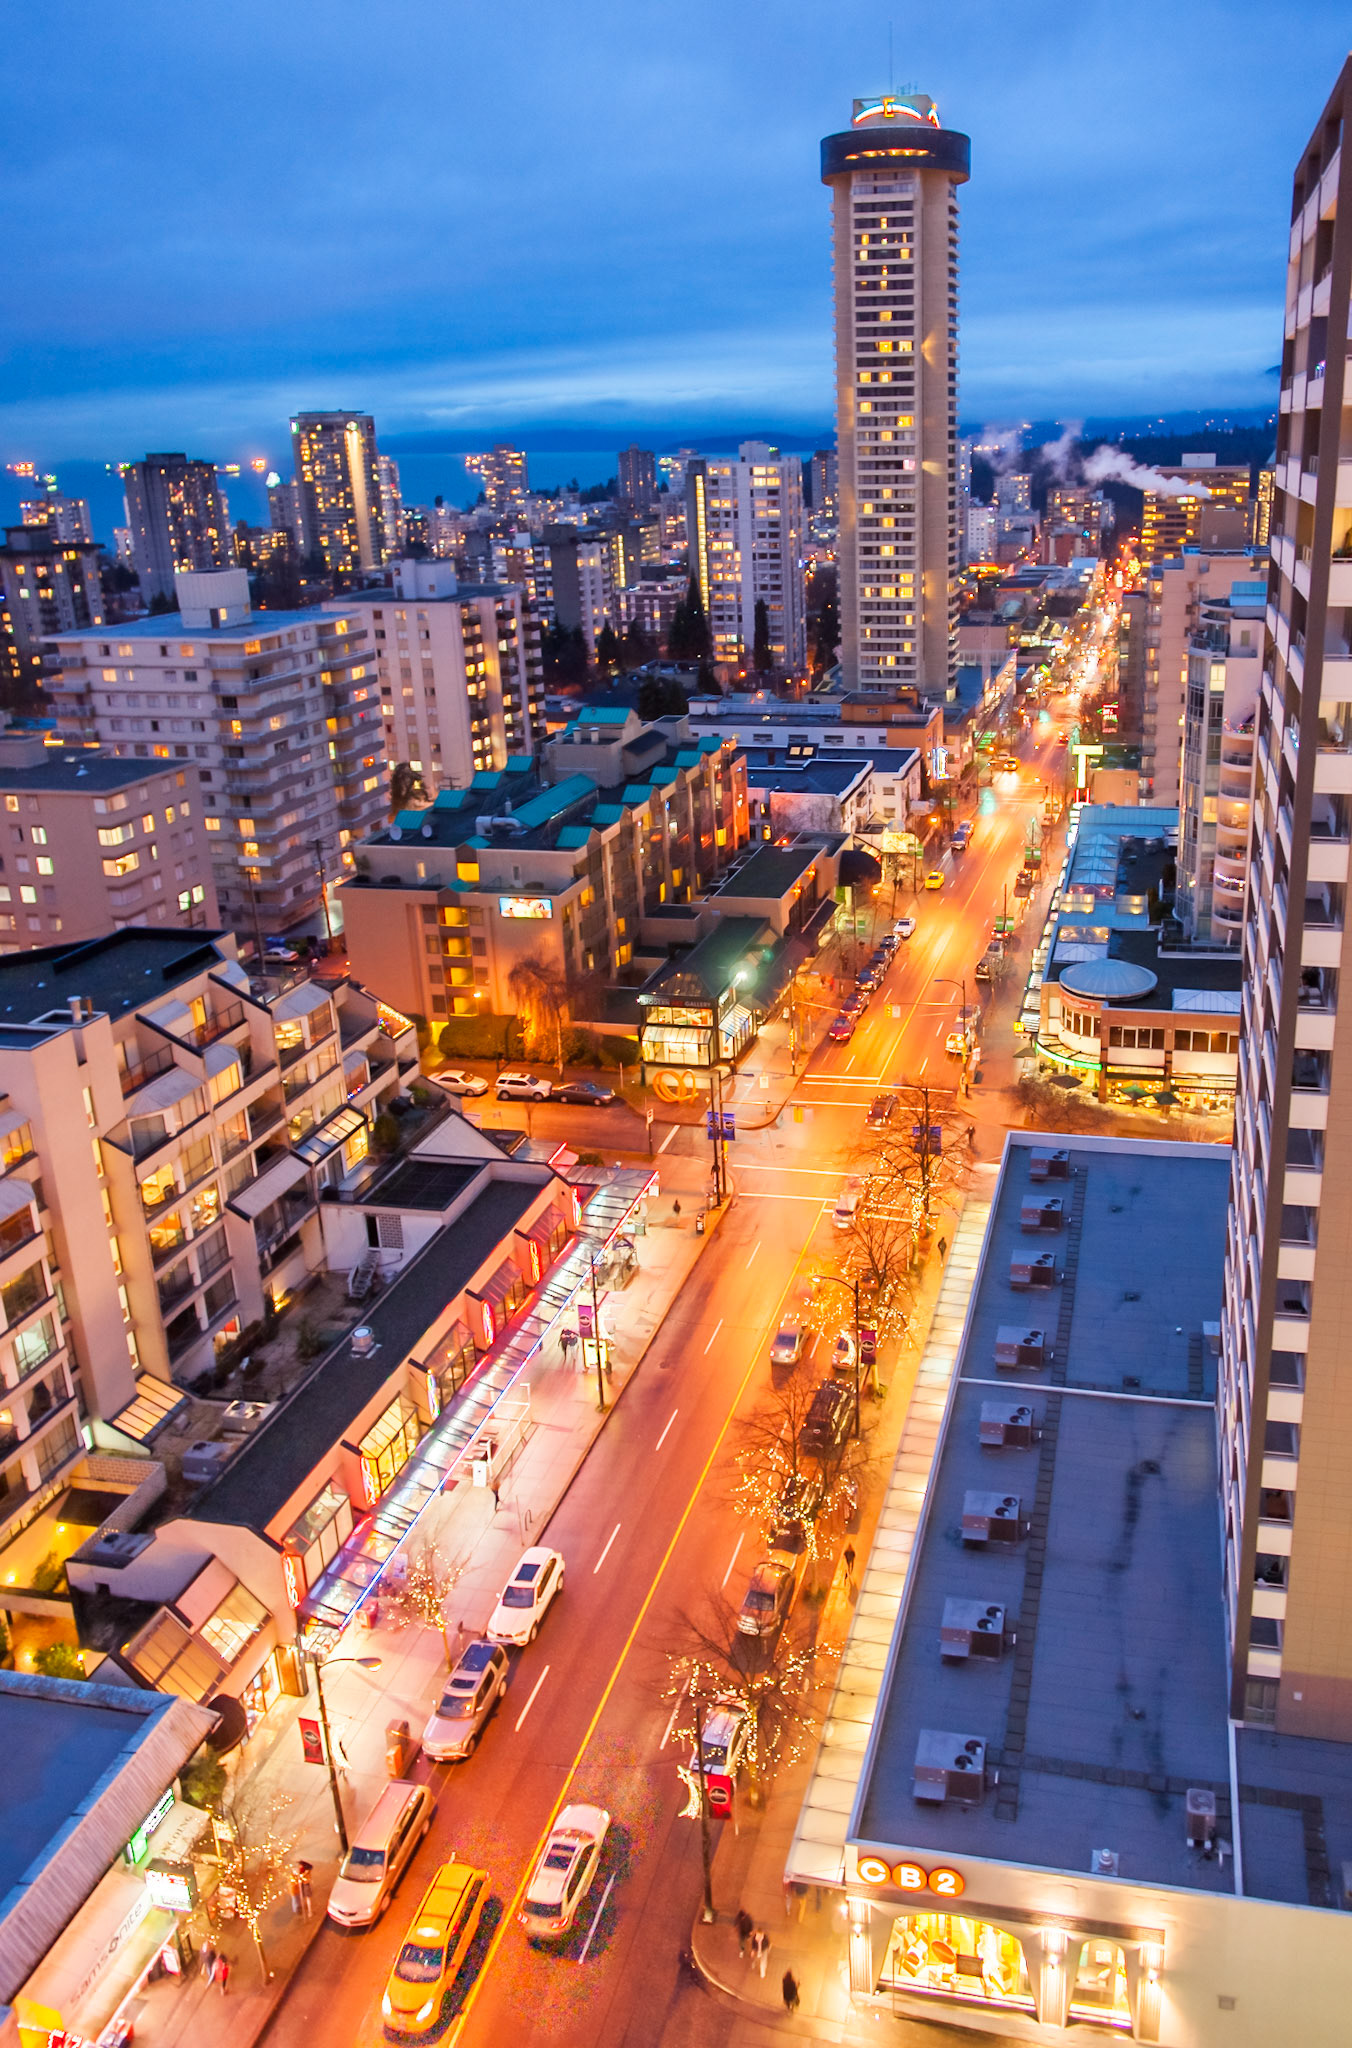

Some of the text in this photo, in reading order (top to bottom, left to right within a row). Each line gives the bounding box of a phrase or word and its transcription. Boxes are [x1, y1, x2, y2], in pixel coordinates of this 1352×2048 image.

[1179, 1087, 1215, 1095] STARBUCKS
[859, 1860, 956, 1895] CB2
[69, 1903, 143, 2004] samsonite
